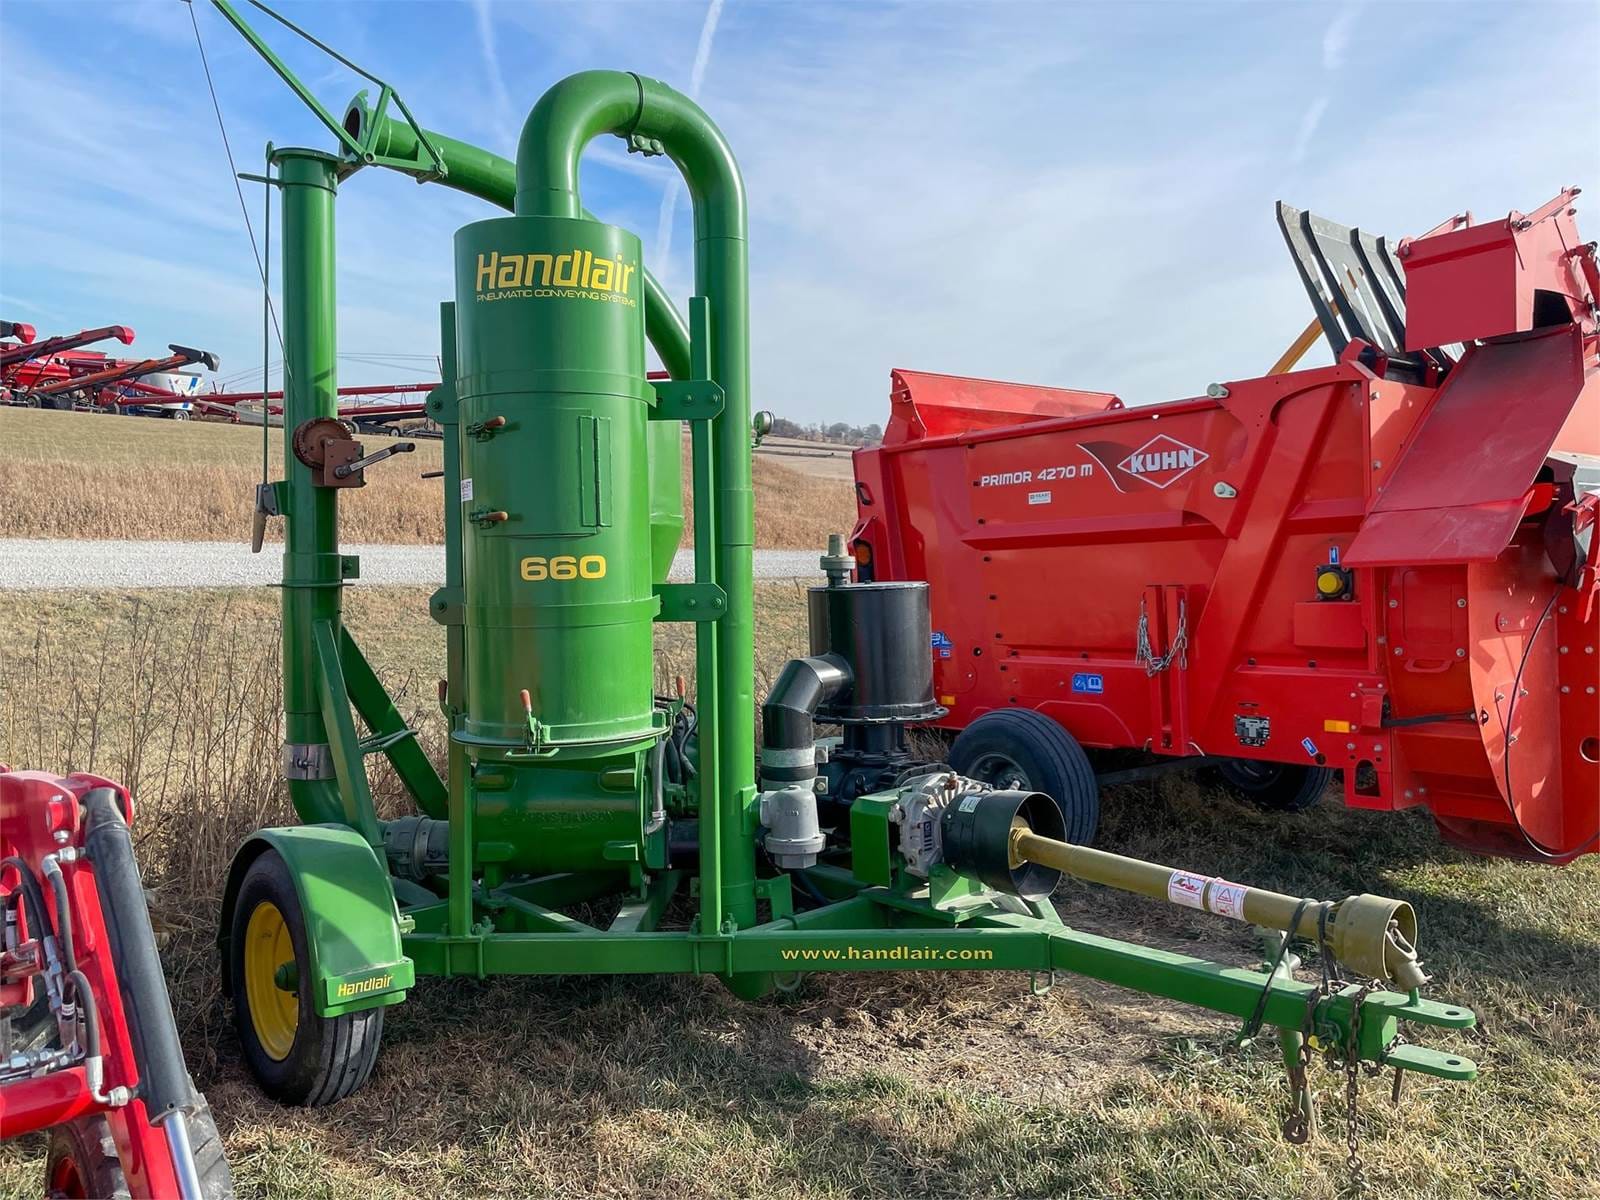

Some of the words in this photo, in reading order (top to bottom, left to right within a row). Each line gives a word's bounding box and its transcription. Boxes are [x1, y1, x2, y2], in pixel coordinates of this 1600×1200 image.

[476, 250, 635, 294] Handlair
[476, 289, 533, 303] PNEUMATIC
[534, 288, 600, 301] CONVEYING
[600, 292, 636, 308] SYSTEMS
[1130, 448, 1195, 474] KUHN
[980, 470, 1032, 487] PRIMOR
[1037, 465, 1076, 480] 4270
[520, 555, 607, 581] 660
[781, 946, 993, 960] www.handlair.com
[337, 974, 394, 997] Handlair
